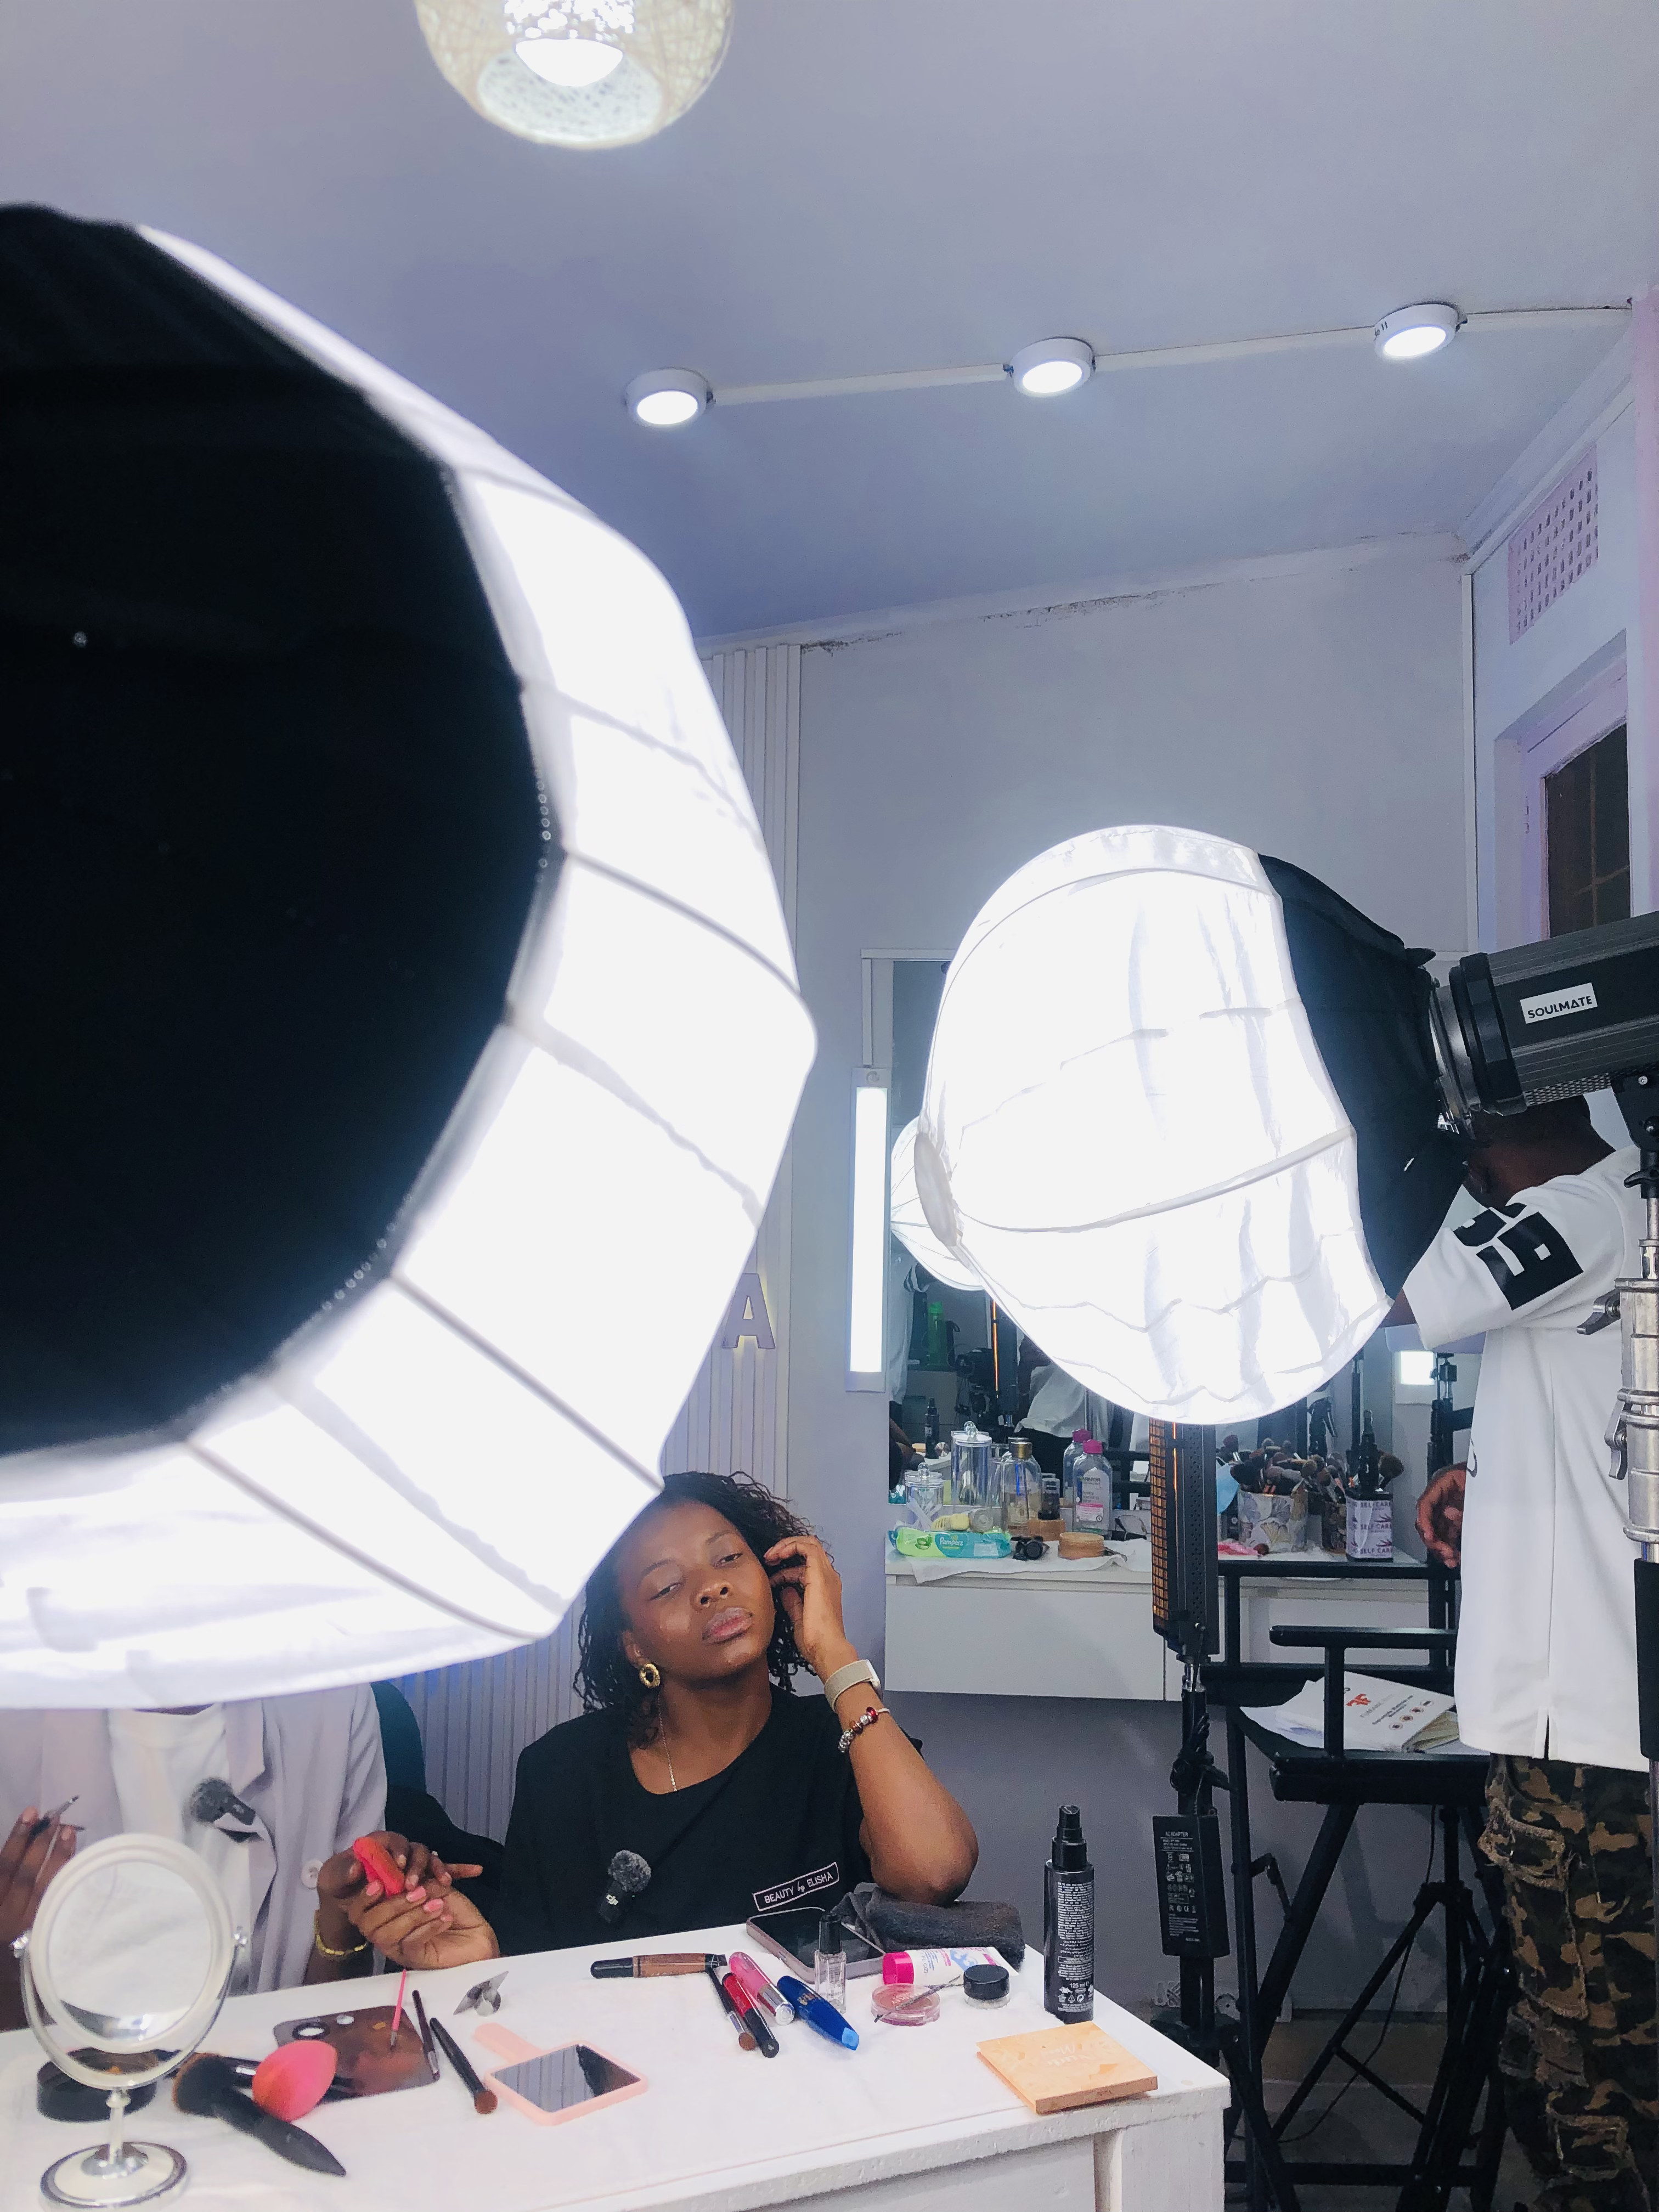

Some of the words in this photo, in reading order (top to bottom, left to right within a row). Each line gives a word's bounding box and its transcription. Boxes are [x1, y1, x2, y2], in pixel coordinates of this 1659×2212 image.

[1527, 995, 1593, 1019] SOULMATE
[940, 1537, 963, 1547] Pampers
[764, 1886, 794, 1904] BEAUTY
[797, 1881, 805, 1893] by
[806, 1872, 833, 1888] ELISHA
